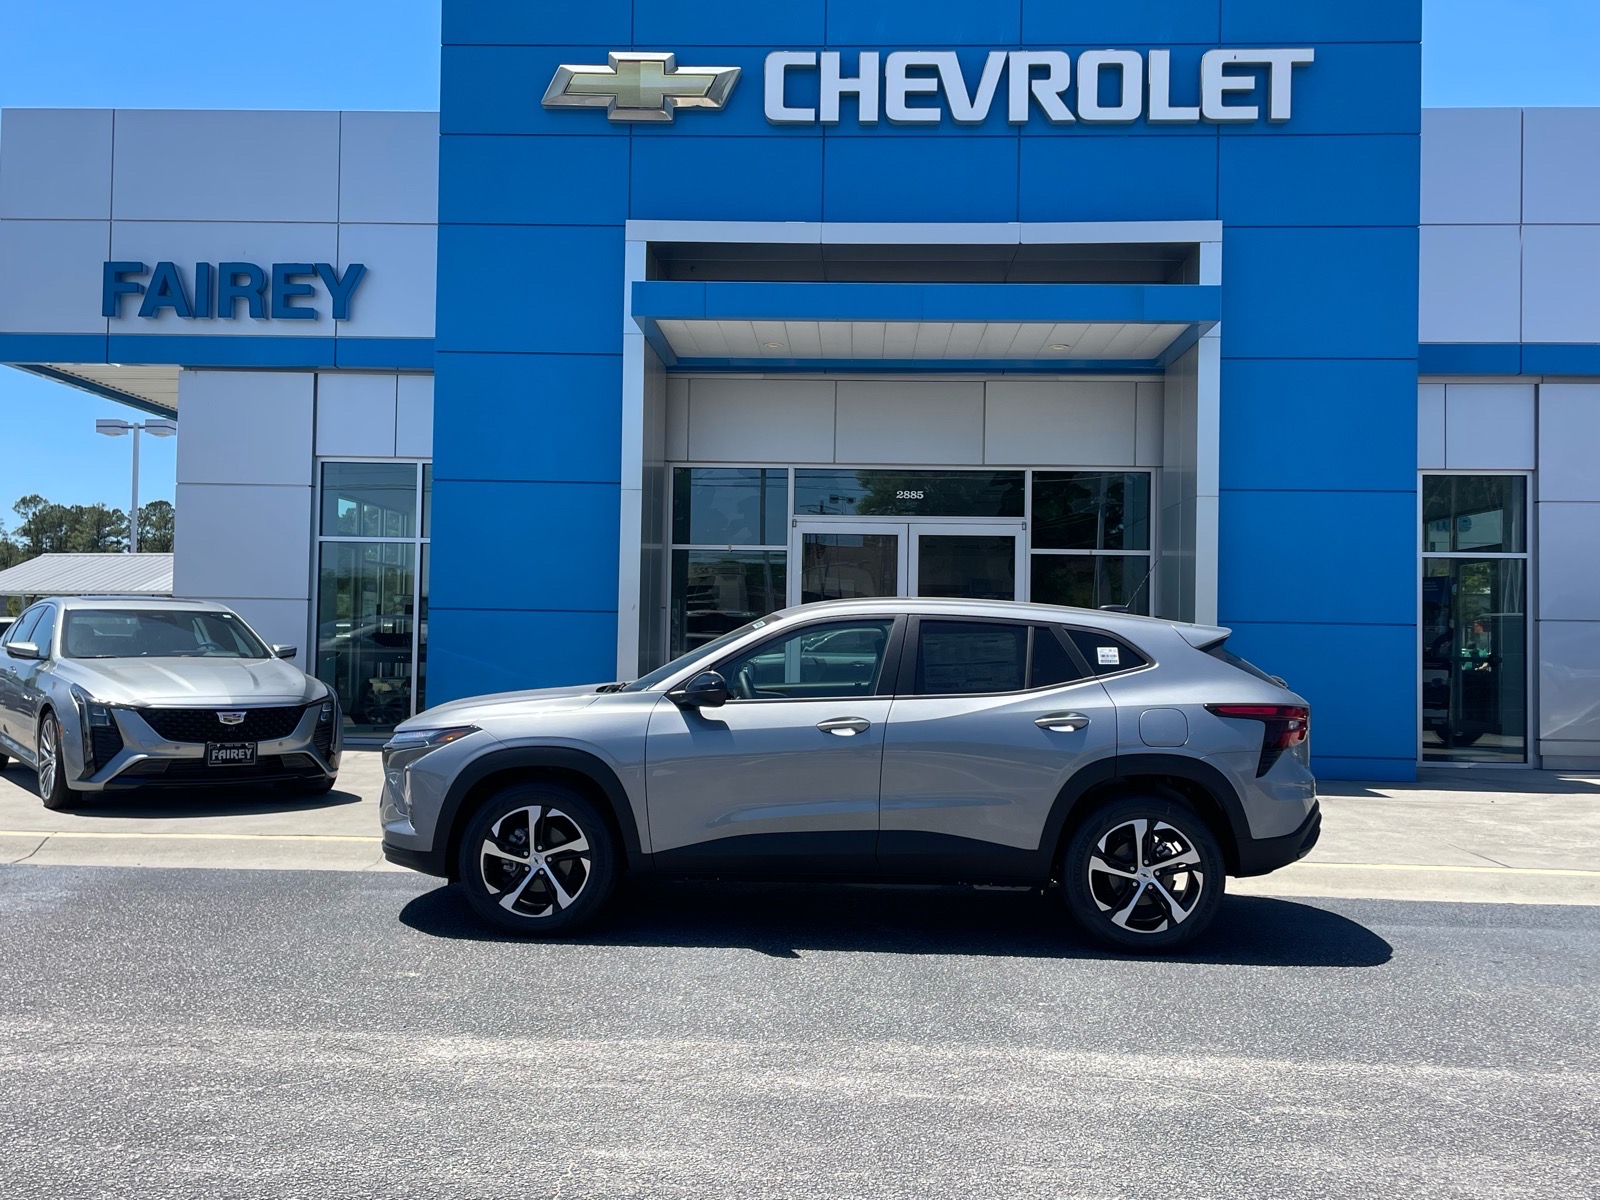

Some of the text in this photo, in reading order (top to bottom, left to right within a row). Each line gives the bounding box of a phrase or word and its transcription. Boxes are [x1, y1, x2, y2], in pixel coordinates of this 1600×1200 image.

[764, 48, 1315, 125] CHEVROLET
[102, 261, 367, 321] FAIREY
[896, 490, 924, 500] 2885
[212, 749, 253, 760] FAIREY
